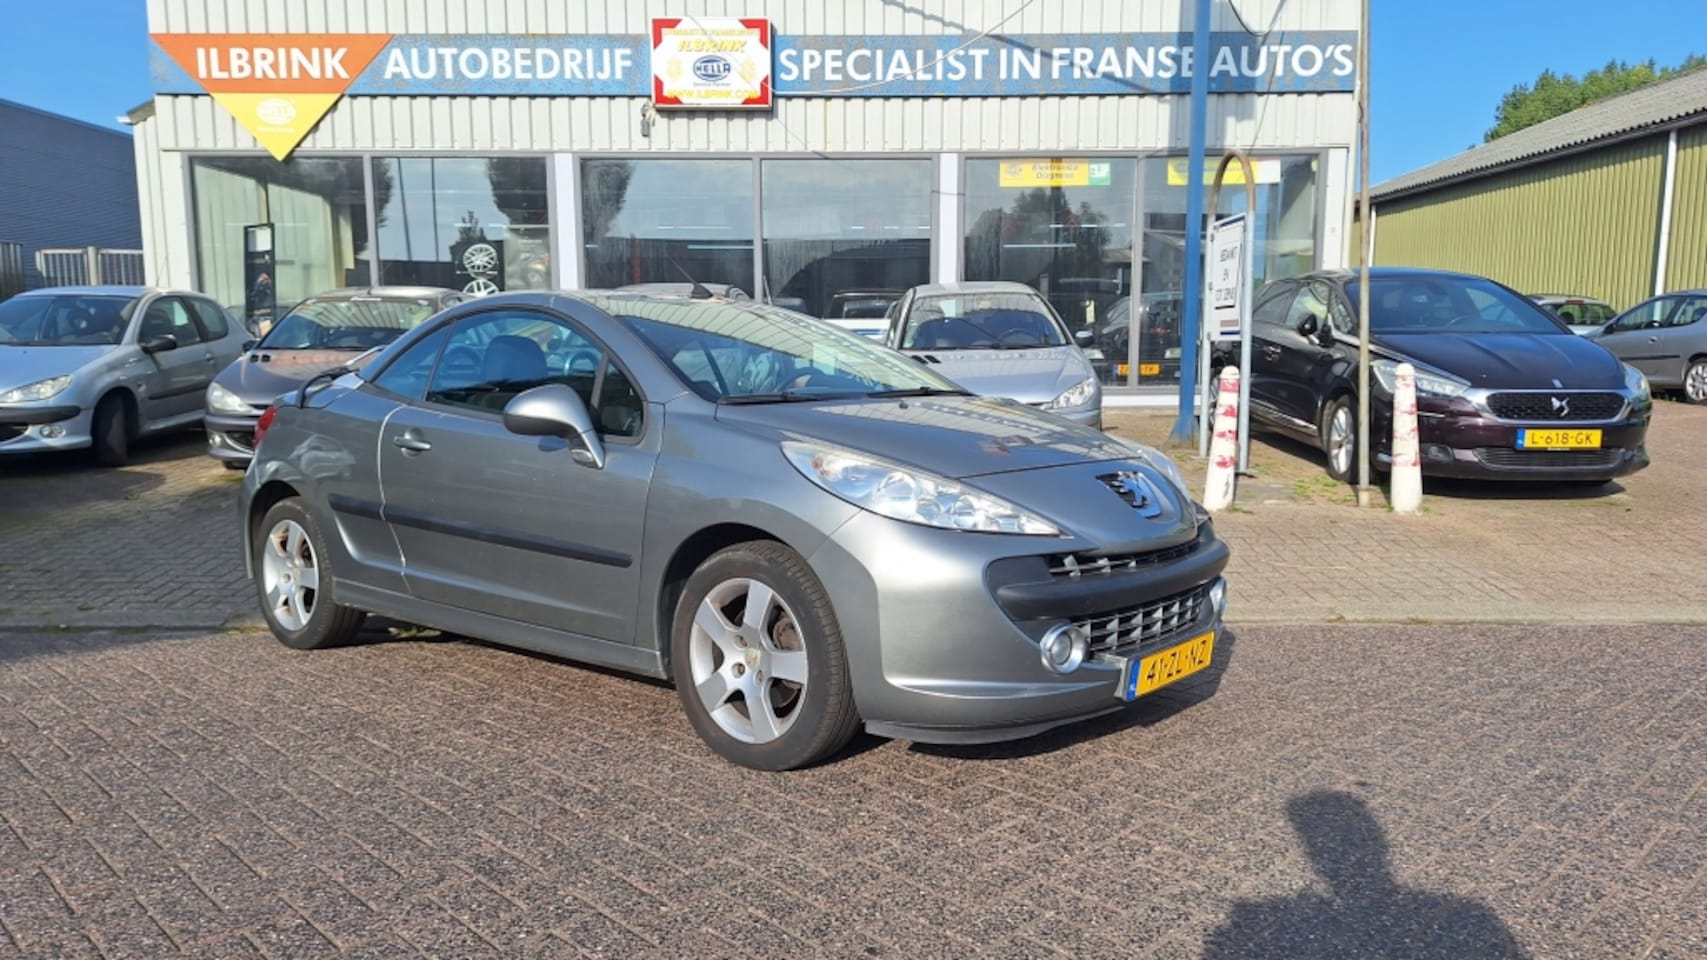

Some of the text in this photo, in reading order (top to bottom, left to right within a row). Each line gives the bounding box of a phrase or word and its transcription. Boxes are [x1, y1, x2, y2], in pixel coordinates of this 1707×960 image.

[196, 47, 349, 79] ILBRINK
[384, 47, 632, 80] AUTOBEDRIJF
[696, 63, 731, 73] HELLA
[779, 44, 1353, 81] SPECIALIST IN FRANSE AUTO'S
[1531, 432, 1593, 445] L-618-GK
[1146, 640, 1207, 686] 41-ZL-NZ
